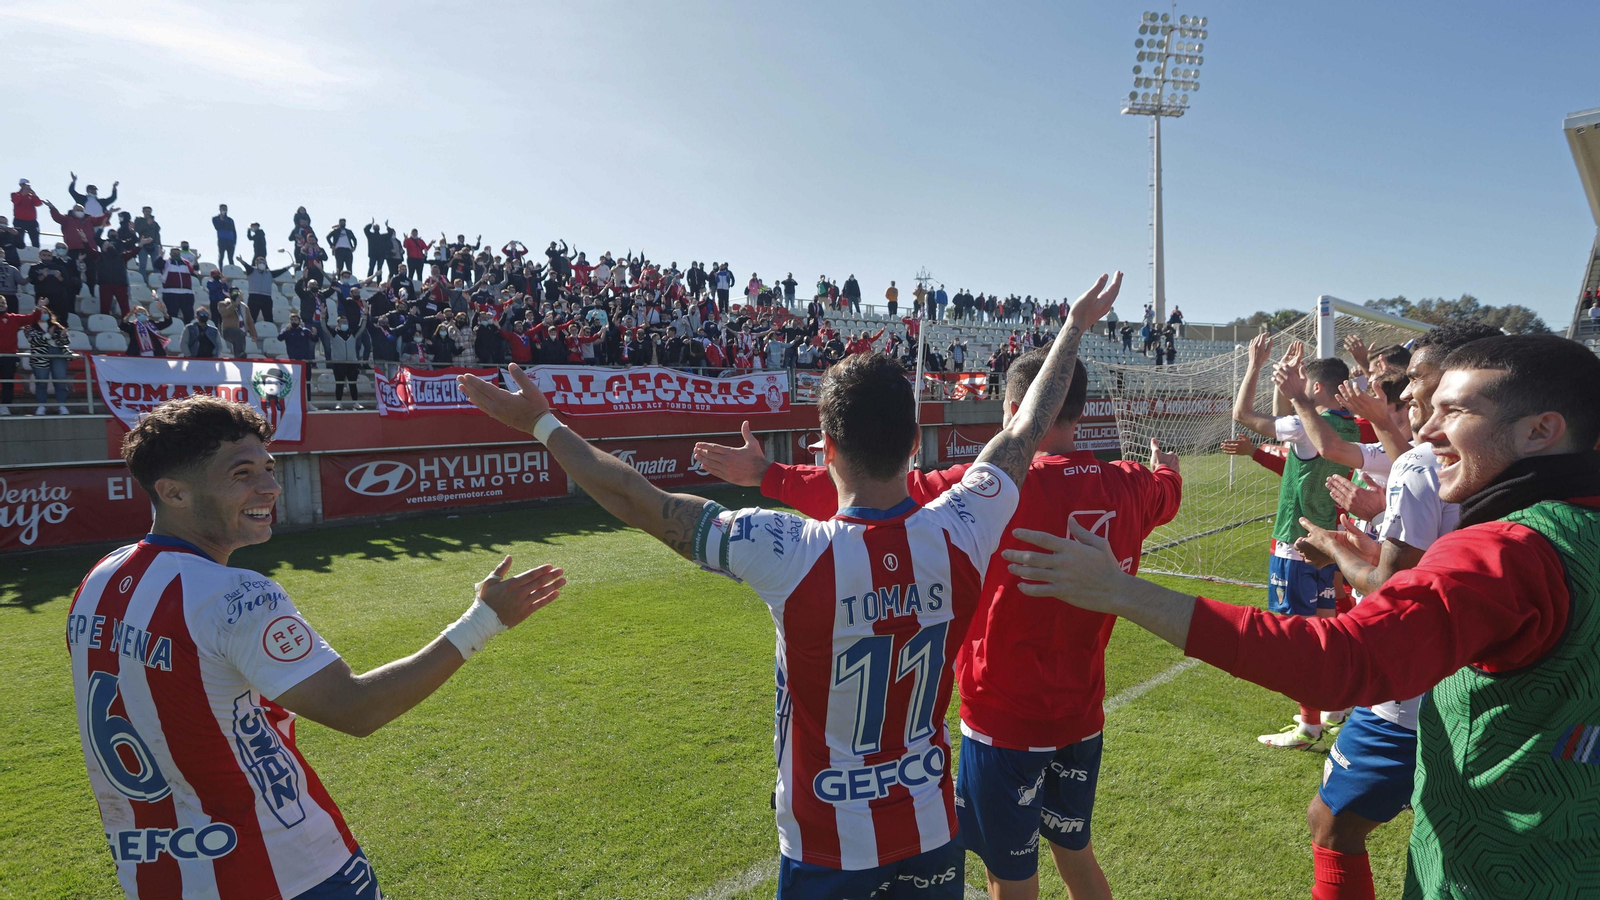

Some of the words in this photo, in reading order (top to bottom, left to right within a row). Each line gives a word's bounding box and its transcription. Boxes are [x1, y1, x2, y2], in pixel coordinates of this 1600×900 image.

[412, 379, 469, 403] ALGECIR
[551, 372, 758, 405] ALGECIRAS
[1083, 401, 1129, 417] ORIZONTE
[419, 451, 549, 480] HYUNDAI
[1063, 464, 1102, 476] GIVO
[406, 488, 503, 504] ventas@permotor.com
[420, 471, 550, 493] PERMOTOR
[224, 588, 241, 602] Bar
[241, 580, 272, 593] Pepe
[840, 582, 944, 628] TOMAS
[67, 614, 106, 649] EPE
[831, 620, 950, 757] 11
[87, 670, 173, 804] 6
[813, 745, 945, 804] GEFCO
